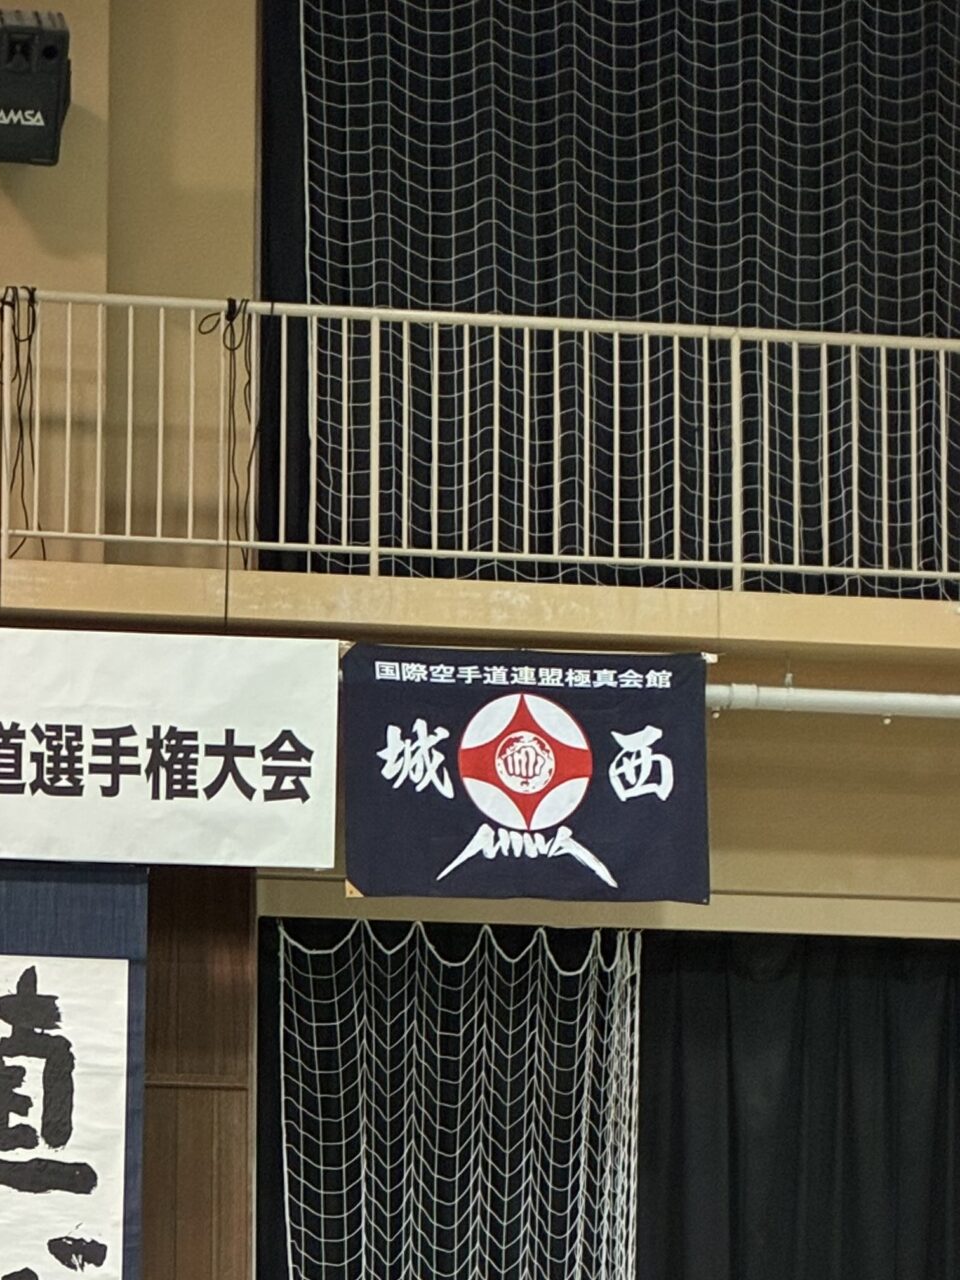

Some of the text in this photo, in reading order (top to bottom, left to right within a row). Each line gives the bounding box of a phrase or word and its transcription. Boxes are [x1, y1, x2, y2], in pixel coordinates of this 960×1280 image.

[374, 660, 674, 690] 国際空手道連盟極真会館
[376, 718, 674, 802] 城 西
